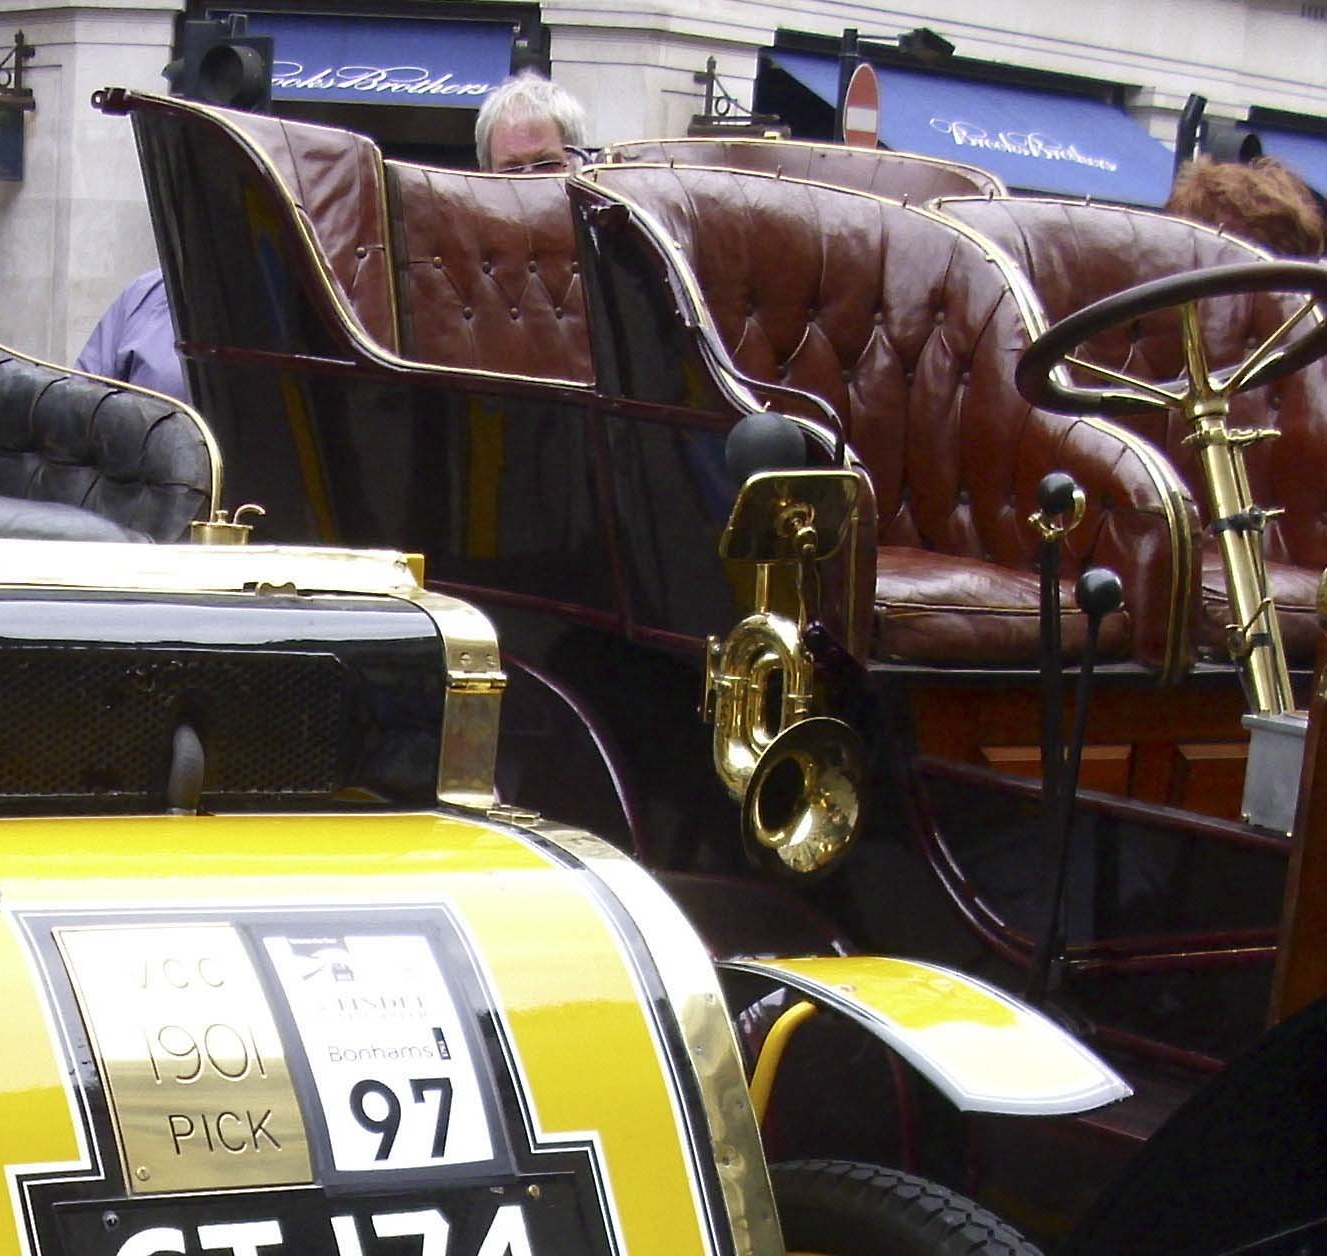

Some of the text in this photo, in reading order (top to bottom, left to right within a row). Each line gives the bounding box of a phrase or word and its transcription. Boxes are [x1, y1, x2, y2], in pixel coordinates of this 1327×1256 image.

[336, 66, 492, 96] Brothers
[142, 1023, 268, 1085] 1901
[327, 1043, 435, 1063] Bonhams
[168, 1108, 283, 1156] PICK
[349, 1077, 454, 1162] 97
